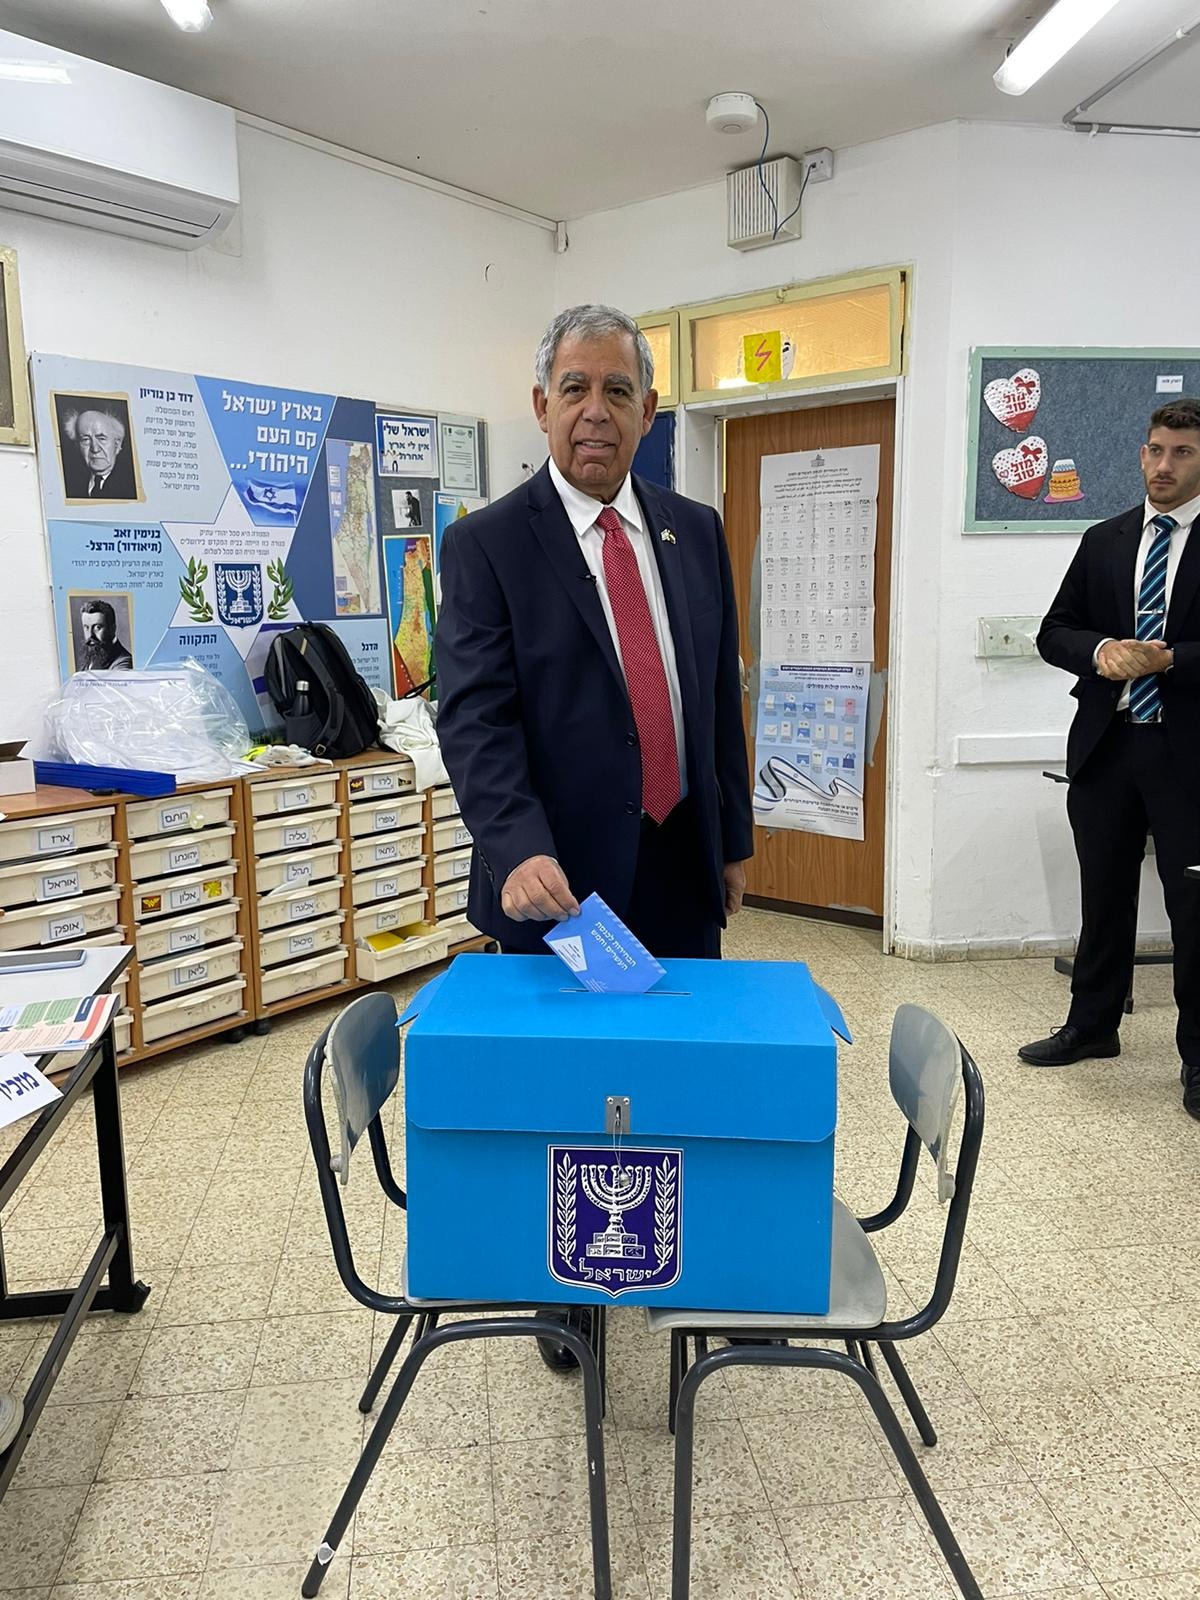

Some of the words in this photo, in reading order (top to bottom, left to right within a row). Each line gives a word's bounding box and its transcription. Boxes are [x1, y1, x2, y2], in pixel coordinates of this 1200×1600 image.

[140, 387, 164, 399] גוריון
[166, 391, 175, 402] בן
[178, 392, 193, 402] דוד
[222, 389, 277, 416] ישראל
[281, 401, 322, 421] בארץ
[383, 422, 400, 435] שלי
[402, 423, 430, 437] ישראל
[257, 426, 291, 445] העם
[295, 430, 317, 450] קם
[389, 442, 405, 450] ארץ
[407, 441, 416, 450] לי
[418, 443, 430, 452] אין
[230, 450, 309, 474] היהודי...
[399, 452, 424, 461] אחרת
[1010, 459, 1033, 472] מזל
[1014, 468, 1035, 482] טוב
[114, 529, 131, 538] זאב
[134, 529, 161, 540] בנימין
[85, 540, 115, 551] הרצל-
[117, 540, 162, 554] (תיאודור)
[228, 613, 256, 624] ישראל
[179, 633, 217, 646] התקווה
[361, 642, 379, 651] הדגל
[164, 811, 189, 823] רותם
[51, 834, 71, 844] ארז
[174, 850, 198, 864] יהונתן
[292, 867, 310, 877] תהל
[47, 878, 77, 890] אוראל
[383, 883, 395, 893] עדן
[179, 890, 197, 904] אלון
[295, 902, 314, 912] אלונה
[53, 921, 80, 937] אופק
[595, 921, 615, 942] לכנסת
[179, 933, 197, 942] אורי
[590, 929, 607, 947] וחמש
[605, 945, 629, 971] העשרים
[612, 940, 637, 967] הבחירות
[579, 1257, 652, 1282] ישראל
